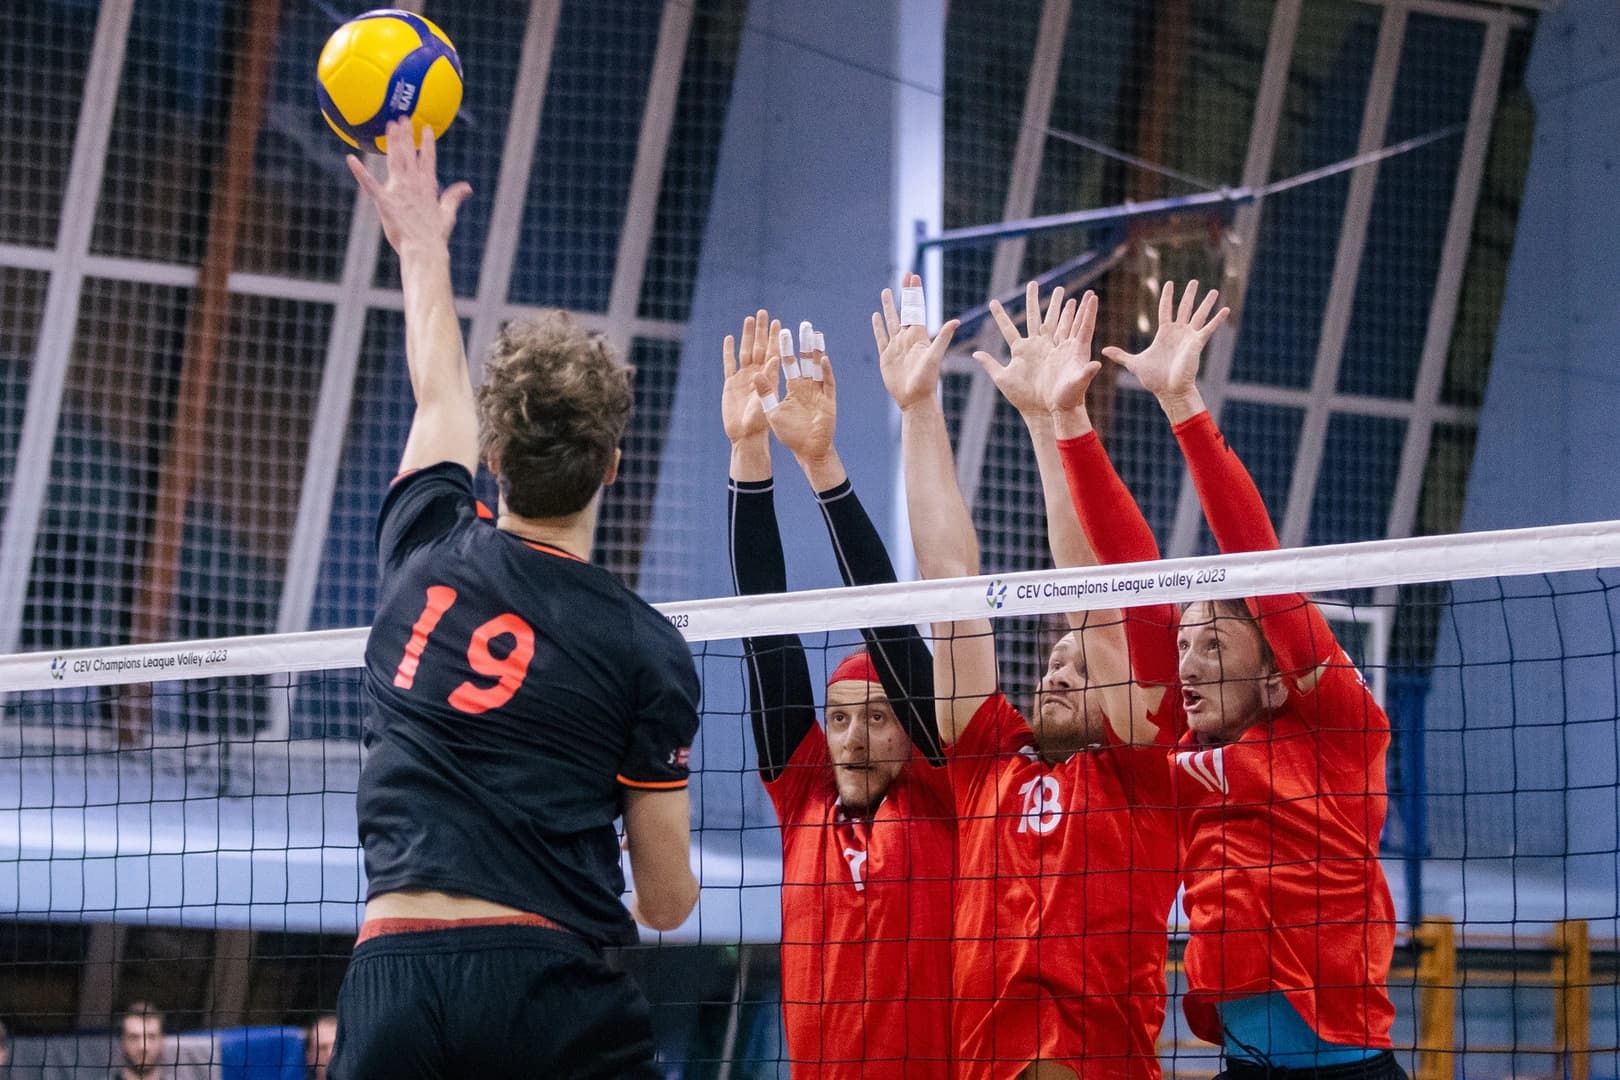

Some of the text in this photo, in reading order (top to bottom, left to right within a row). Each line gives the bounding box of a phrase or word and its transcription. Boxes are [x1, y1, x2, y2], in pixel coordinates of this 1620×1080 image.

[1016, 568, 1226, 599] CEV Champions League Volley 2023
[73, 649, 228, 673] CEV Champions League Volley 2023
[393, 585, 536, 714] 19
[1017, 775, 1063, 833] 18
[843, 847, 867, 892] 7
